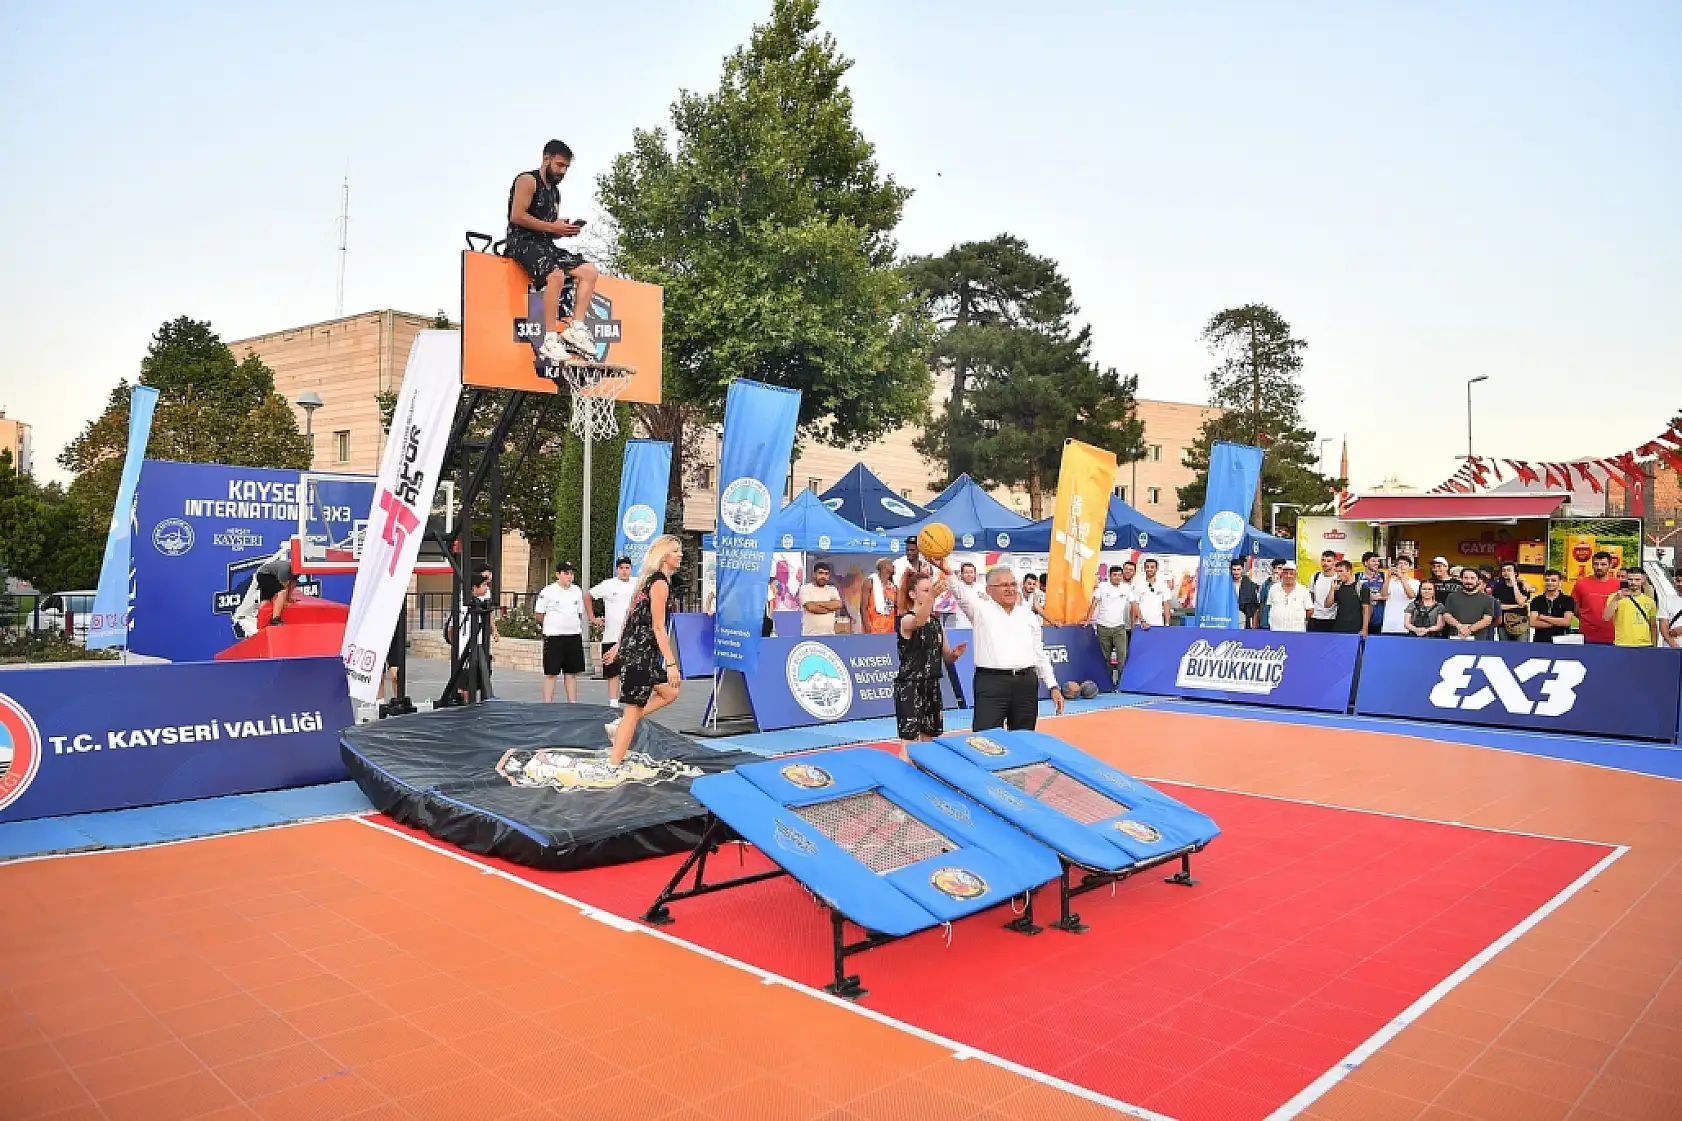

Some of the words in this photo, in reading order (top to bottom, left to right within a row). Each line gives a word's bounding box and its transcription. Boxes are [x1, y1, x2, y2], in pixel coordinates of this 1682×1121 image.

[517, 323, 541, 336] 3X3
[594, 324, 620, 338] FIBA
[185, 499, 318, 521] INTERNATIONL
[49, 734, 102, 754] T.C.
[108, 719, 220, 750] KAYSERİ
[224, 710, 323, 739] VALİLİĞİ
